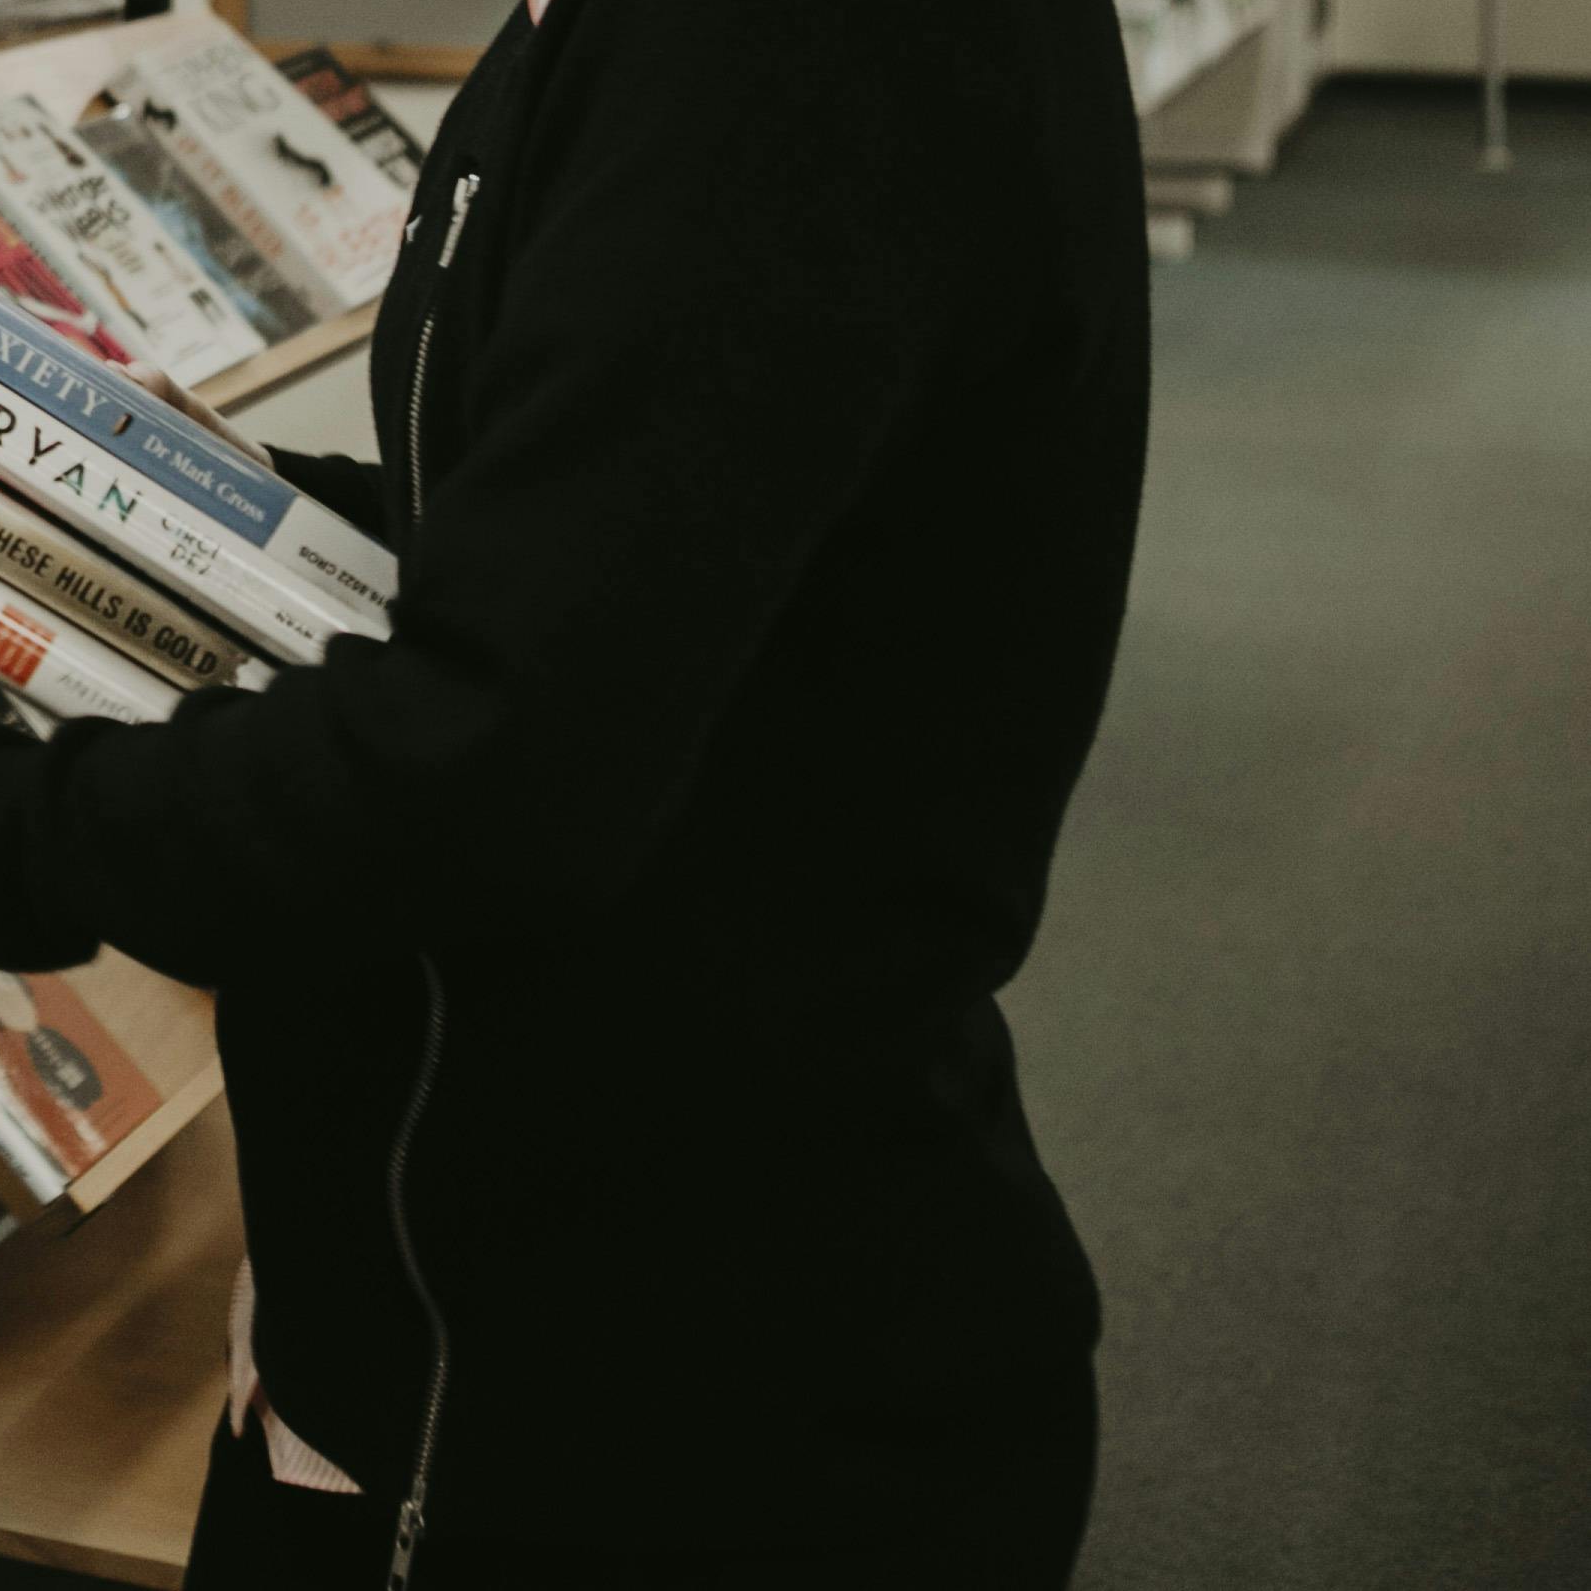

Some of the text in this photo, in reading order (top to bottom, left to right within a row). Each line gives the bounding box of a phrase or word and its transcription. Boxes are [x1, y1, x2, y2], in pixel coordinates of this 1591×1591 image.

[141, 434, 170, 460] Dr
[171, 449, 221, 491] Mark
[216, 480, 266, 523] Cross
[56, 565, 122, 621] HILLS
[123, 607, 150, 637] IS
[154, 626, 219, 678] GOLD
